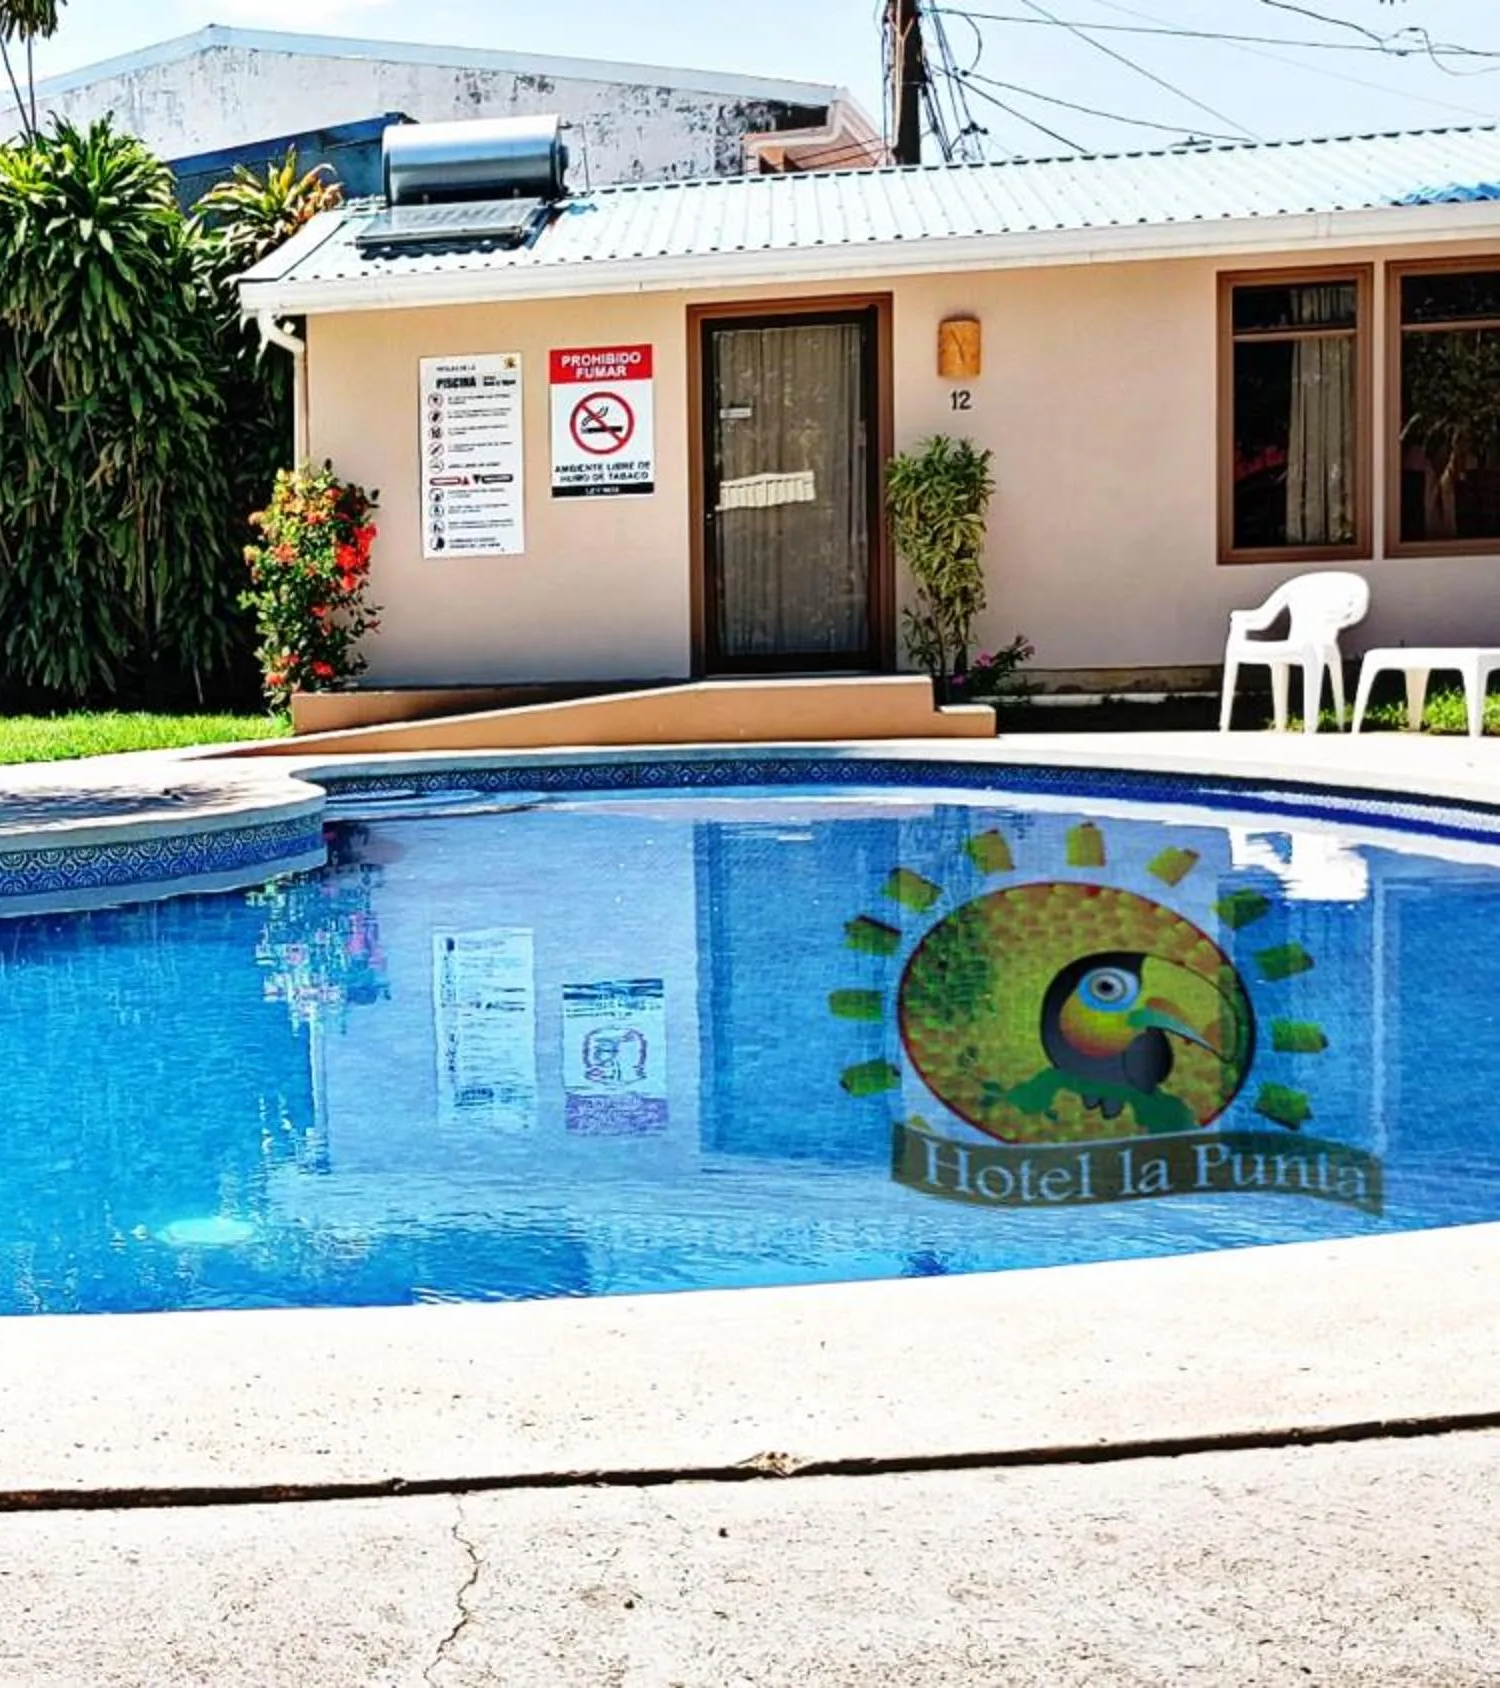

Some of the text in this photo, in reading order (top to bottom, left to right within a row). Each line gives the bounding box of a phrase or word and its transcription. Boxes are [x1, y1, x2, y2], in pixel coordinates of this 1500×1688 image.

[561, 352, 641, 368] PROHIBIDO
[576, 366, 627, 379] FUMAR
[436, 376, 477, 389] PISCINA
[950, 390, 972, 410] 12
[555, 460, 651, 473] AMBIENTE LIBRE DE
[593, 472, 606, 481] DE
[609, 470, 649, 481] TABACO
